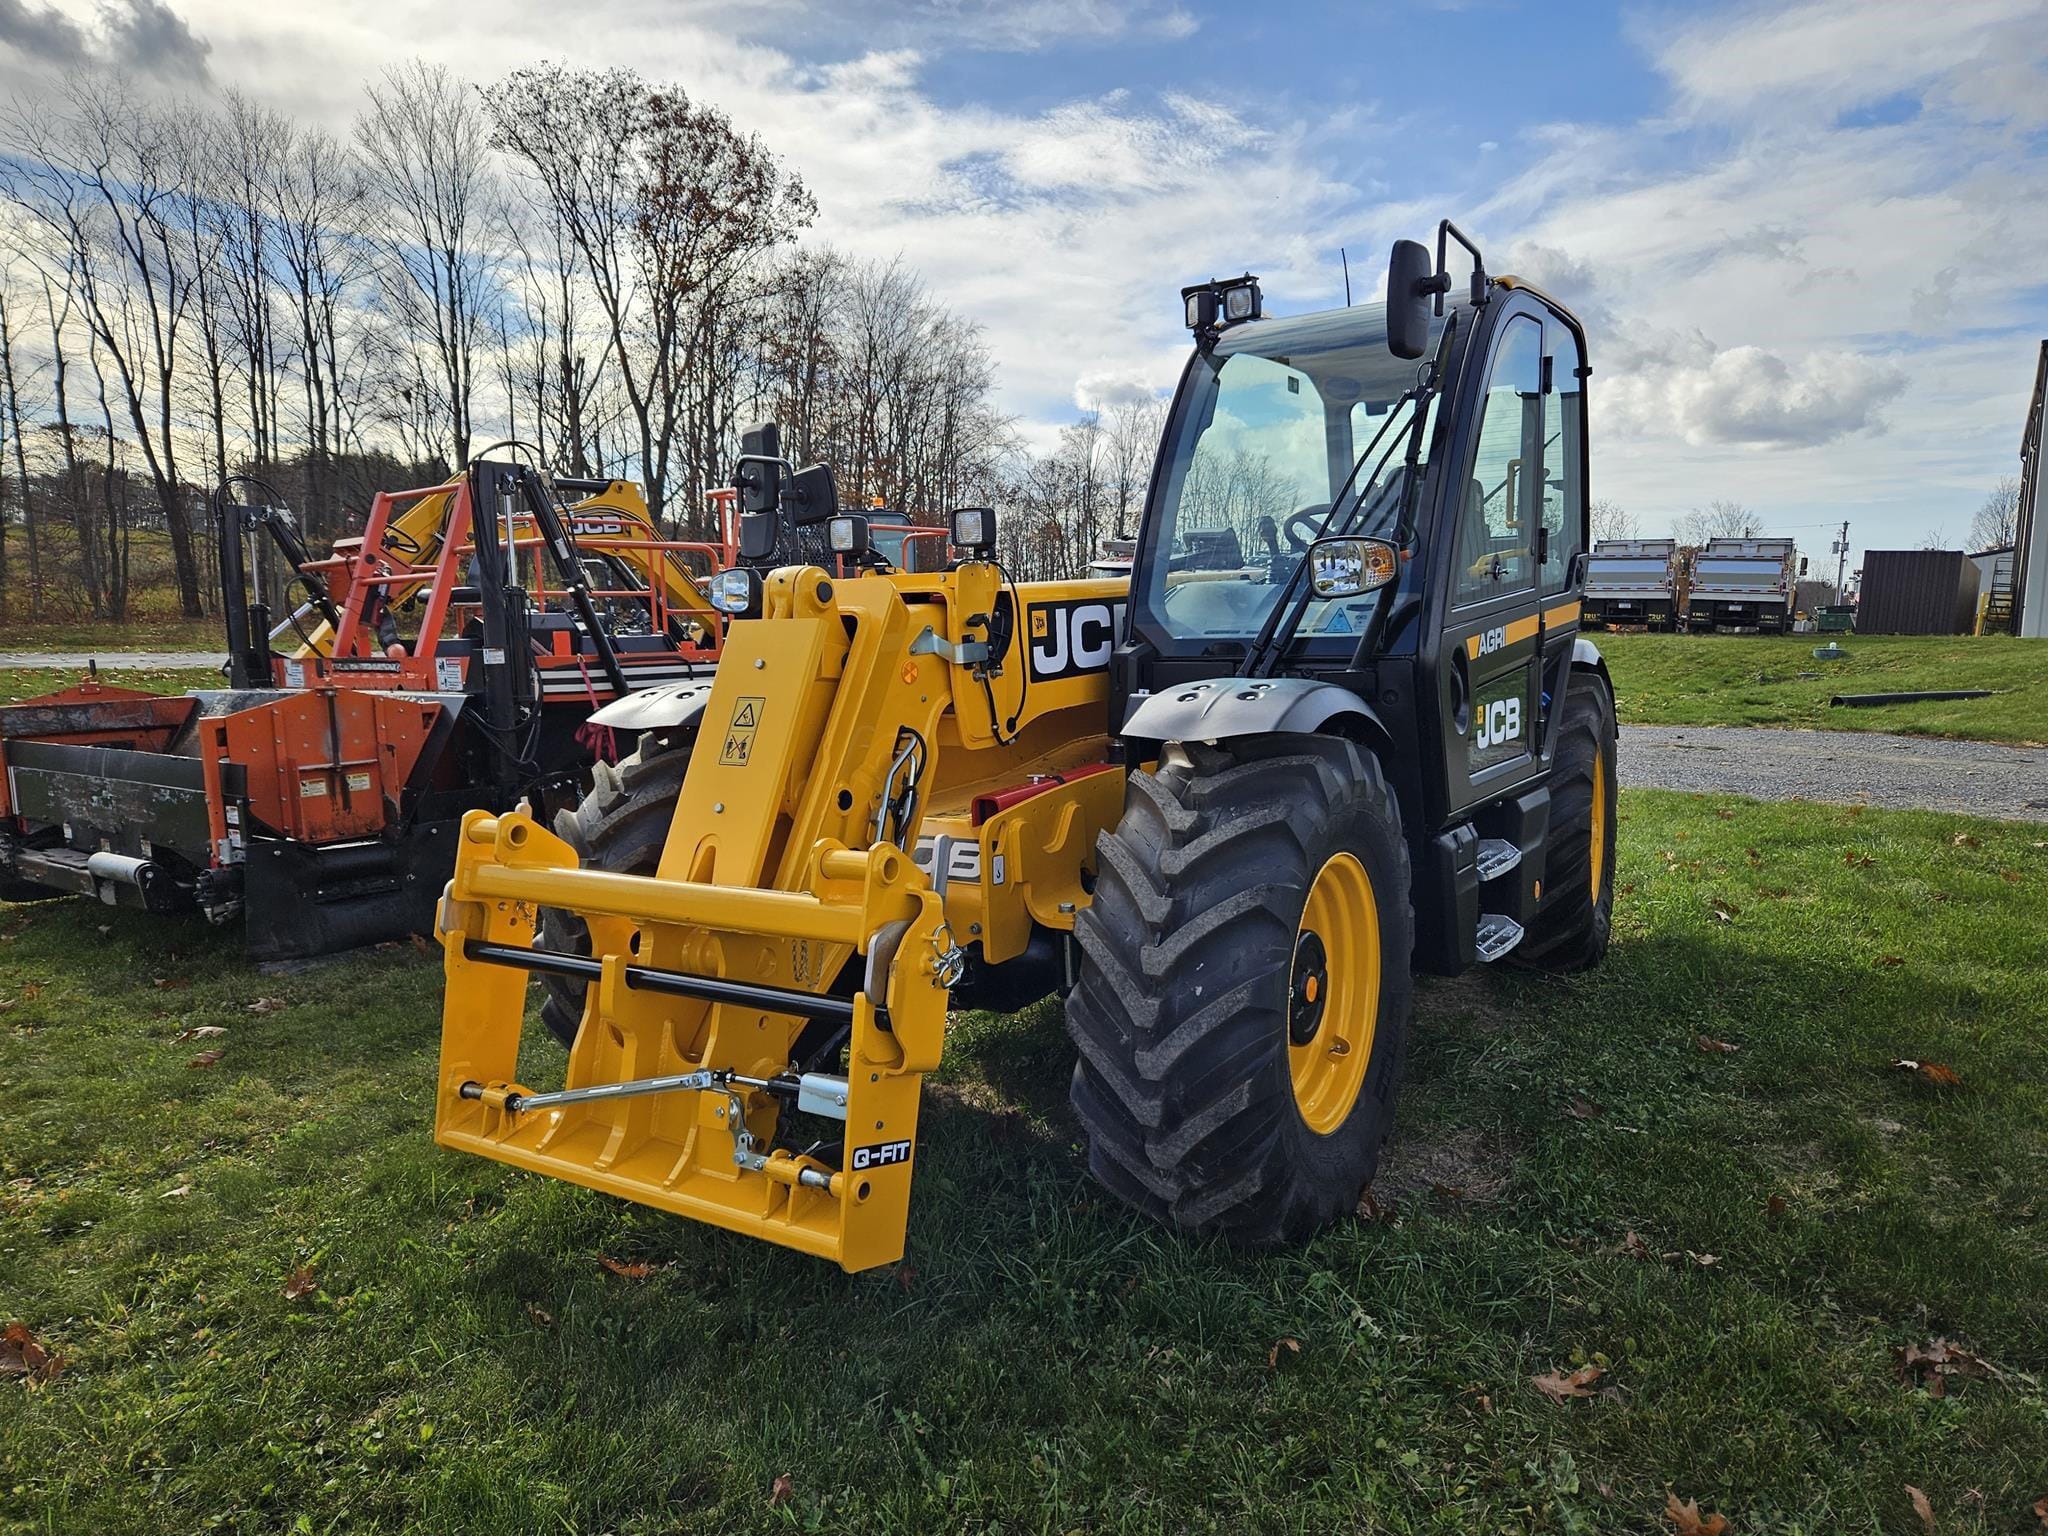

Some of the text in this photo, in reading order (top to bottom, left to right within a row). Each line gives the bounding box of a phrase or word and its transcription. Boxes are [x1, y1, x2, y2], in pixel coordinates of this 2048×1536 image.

[1478, 625, 1506, 657] AGRI
[1477, 697, 1520, 749] JCB
[853, 1142, 910, 1168] Q-FIT
